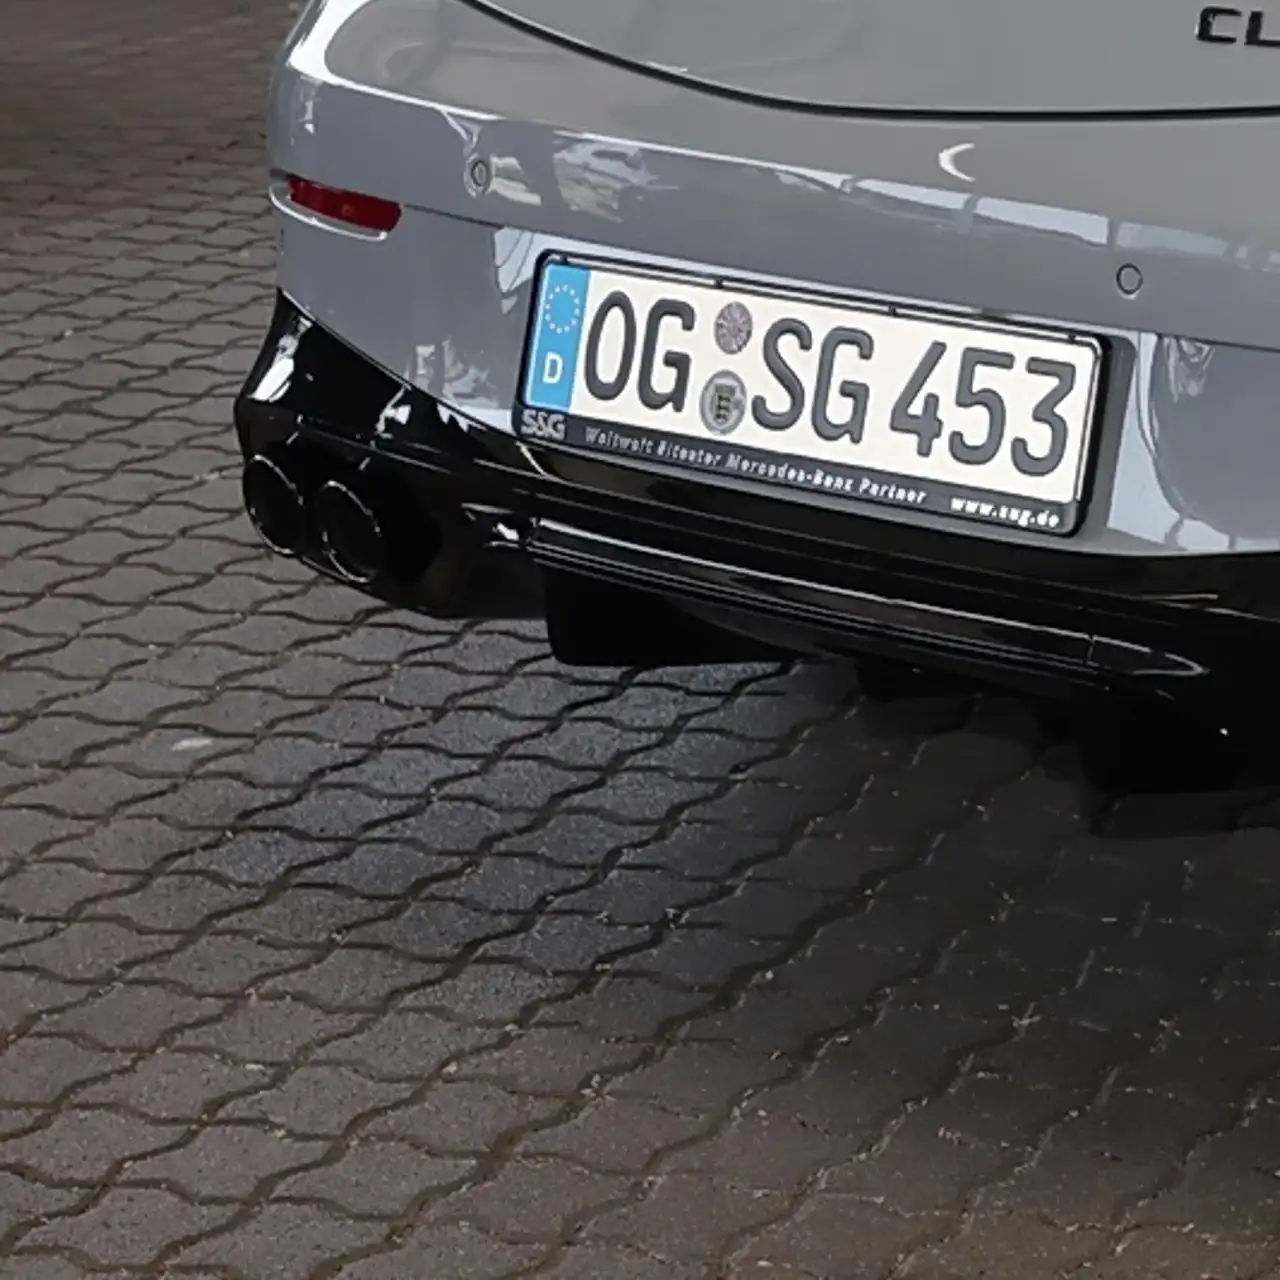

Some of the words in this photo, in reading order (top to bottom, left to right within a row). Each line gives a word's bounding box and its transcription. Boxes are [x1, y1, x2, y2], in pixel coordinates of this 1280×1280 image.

[542, 352, 564, 384] D
[583, 289, 696, 413] OG
[751, 317, 874, 444] SG
[889, 340, 1077, 477] 453
[724, 452, 855, 492] Mercedes-Benz
[858, 476, 928, 504] Partner
